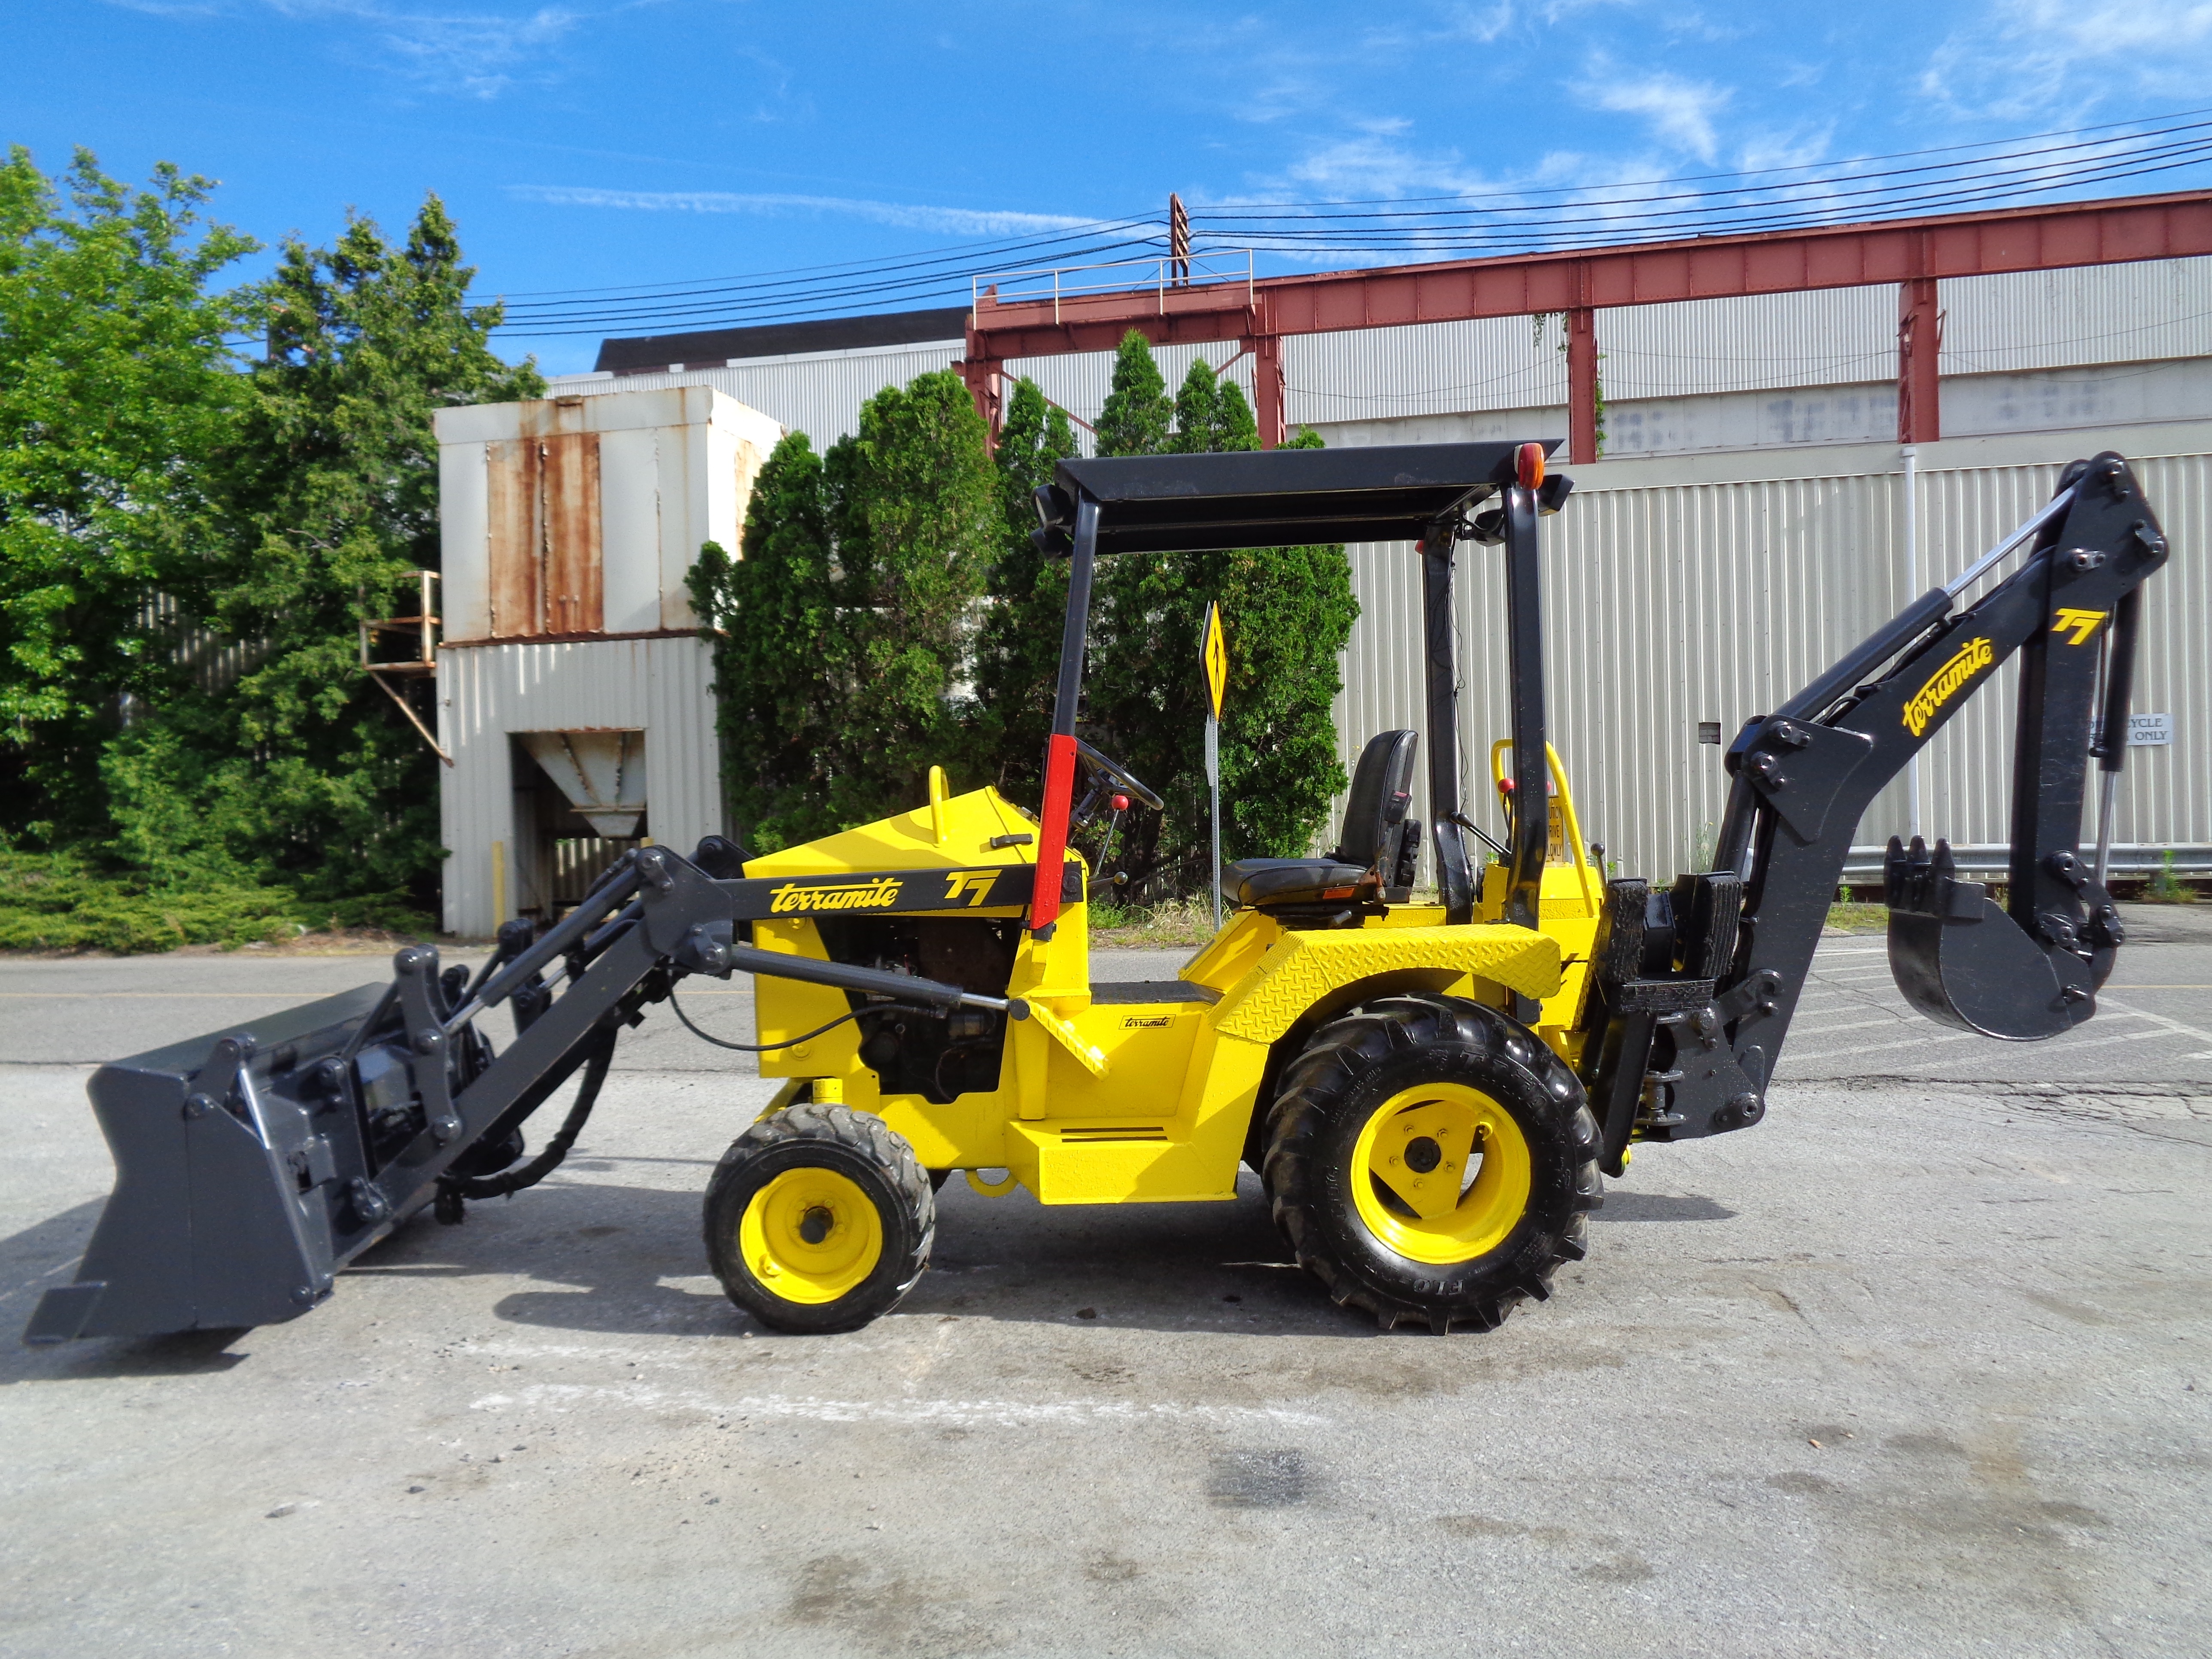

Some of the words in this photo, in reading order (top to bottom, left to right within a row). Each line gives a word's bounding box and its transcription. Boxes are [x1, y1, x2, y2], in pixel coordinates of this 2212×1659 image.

[1902, 637, 1993, 737] terramite
[2128, 718, 2163, 728] YCLE
[2135, 730, 2168, 740] ONLY
[1549, 806, 1562, 819] UTION
[1549, 825, 1559, 838] RIVE
[1547, 843, 1562, 856] LOWLY
[769, 877, 903, 913] terramite
[1124, 1016, 1171, 1027] terramite
